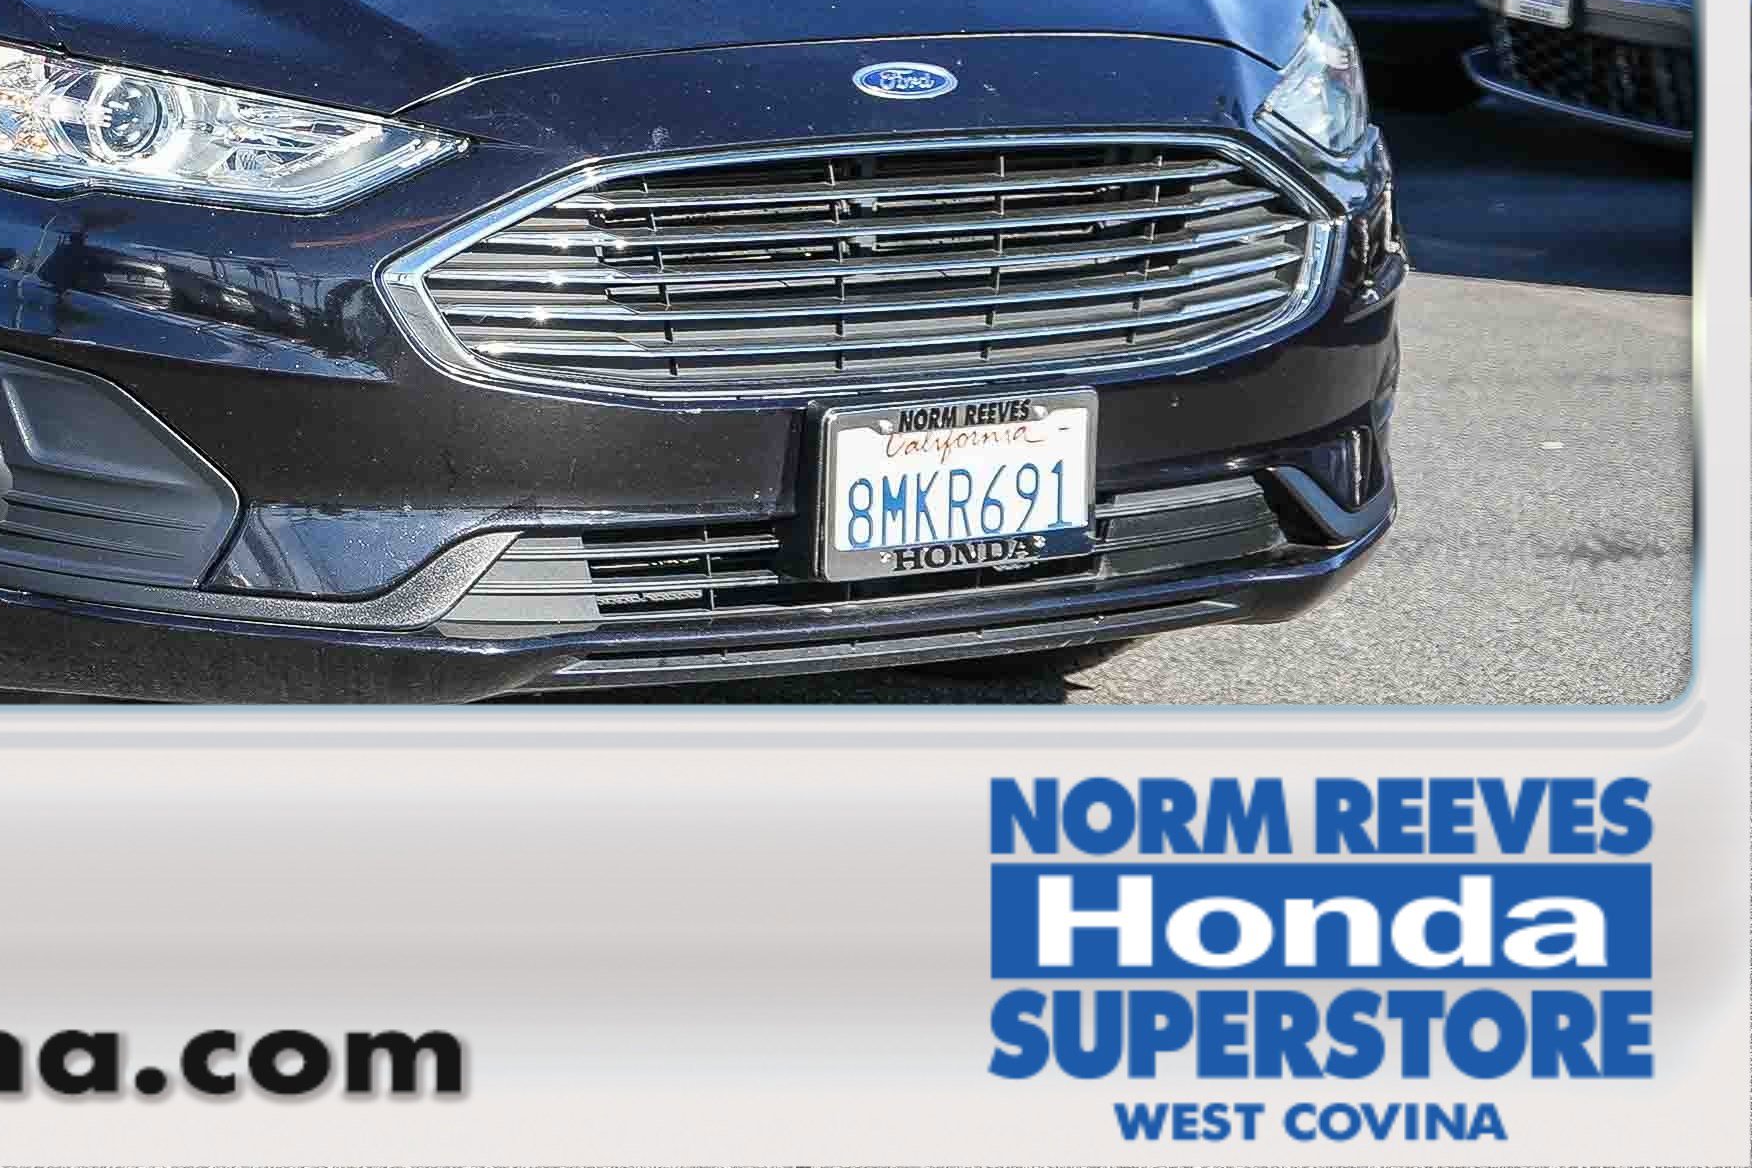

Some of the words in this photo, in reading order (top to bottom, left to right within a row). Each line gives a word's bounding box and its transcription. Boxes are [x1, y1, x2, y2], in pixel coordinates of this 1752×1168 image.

[898, 405, 958, 433] NORM
[964, 398, 1032, 426] REEVES
[885, 425, 1046, 464] California
[848, 459, 1073, 550] 8MKR691
[893, 535, 1044, 573] HONDA
